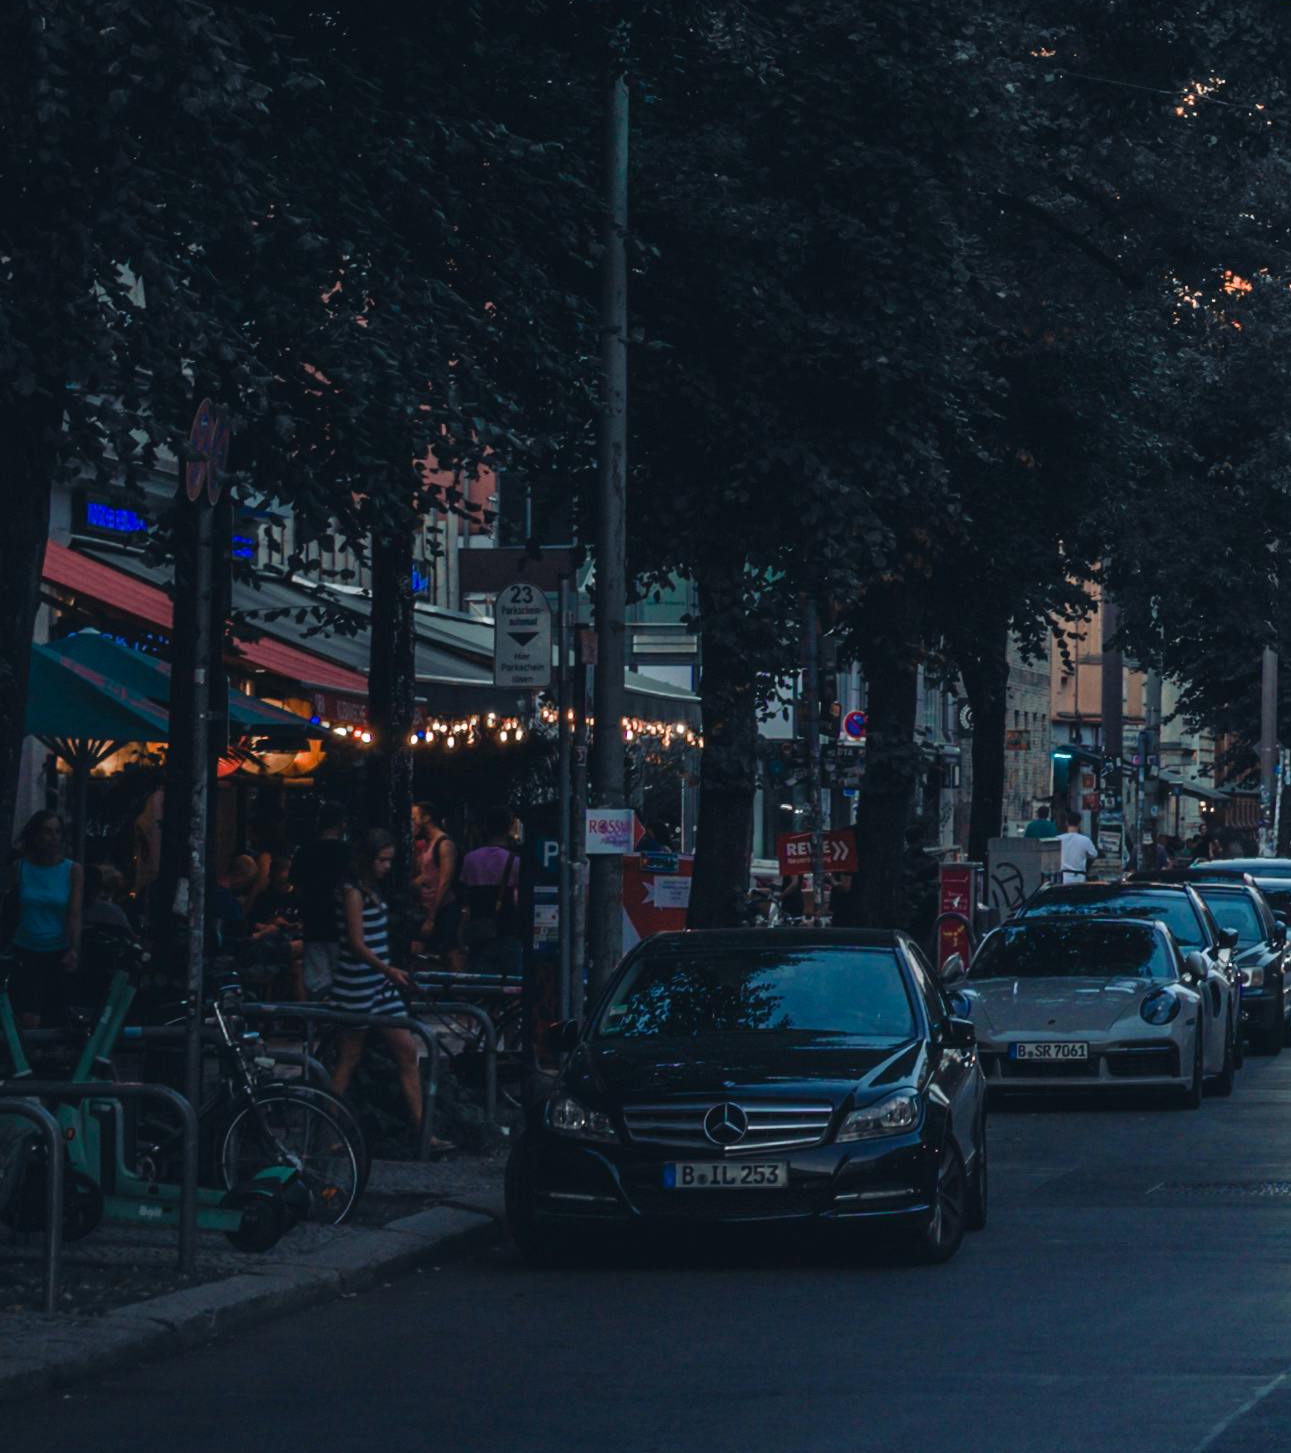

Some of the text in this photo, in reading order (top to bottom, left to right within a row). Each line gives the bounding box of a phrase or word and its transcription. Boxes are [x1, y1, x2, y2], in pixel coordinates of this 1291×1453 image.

[511, 586, 533, 603] 23
[544, 841, 559, 868] P
[1018, 1045, 1085, 1057] B SR 7061
[682, 1165, 779, 1185] B IL 253
